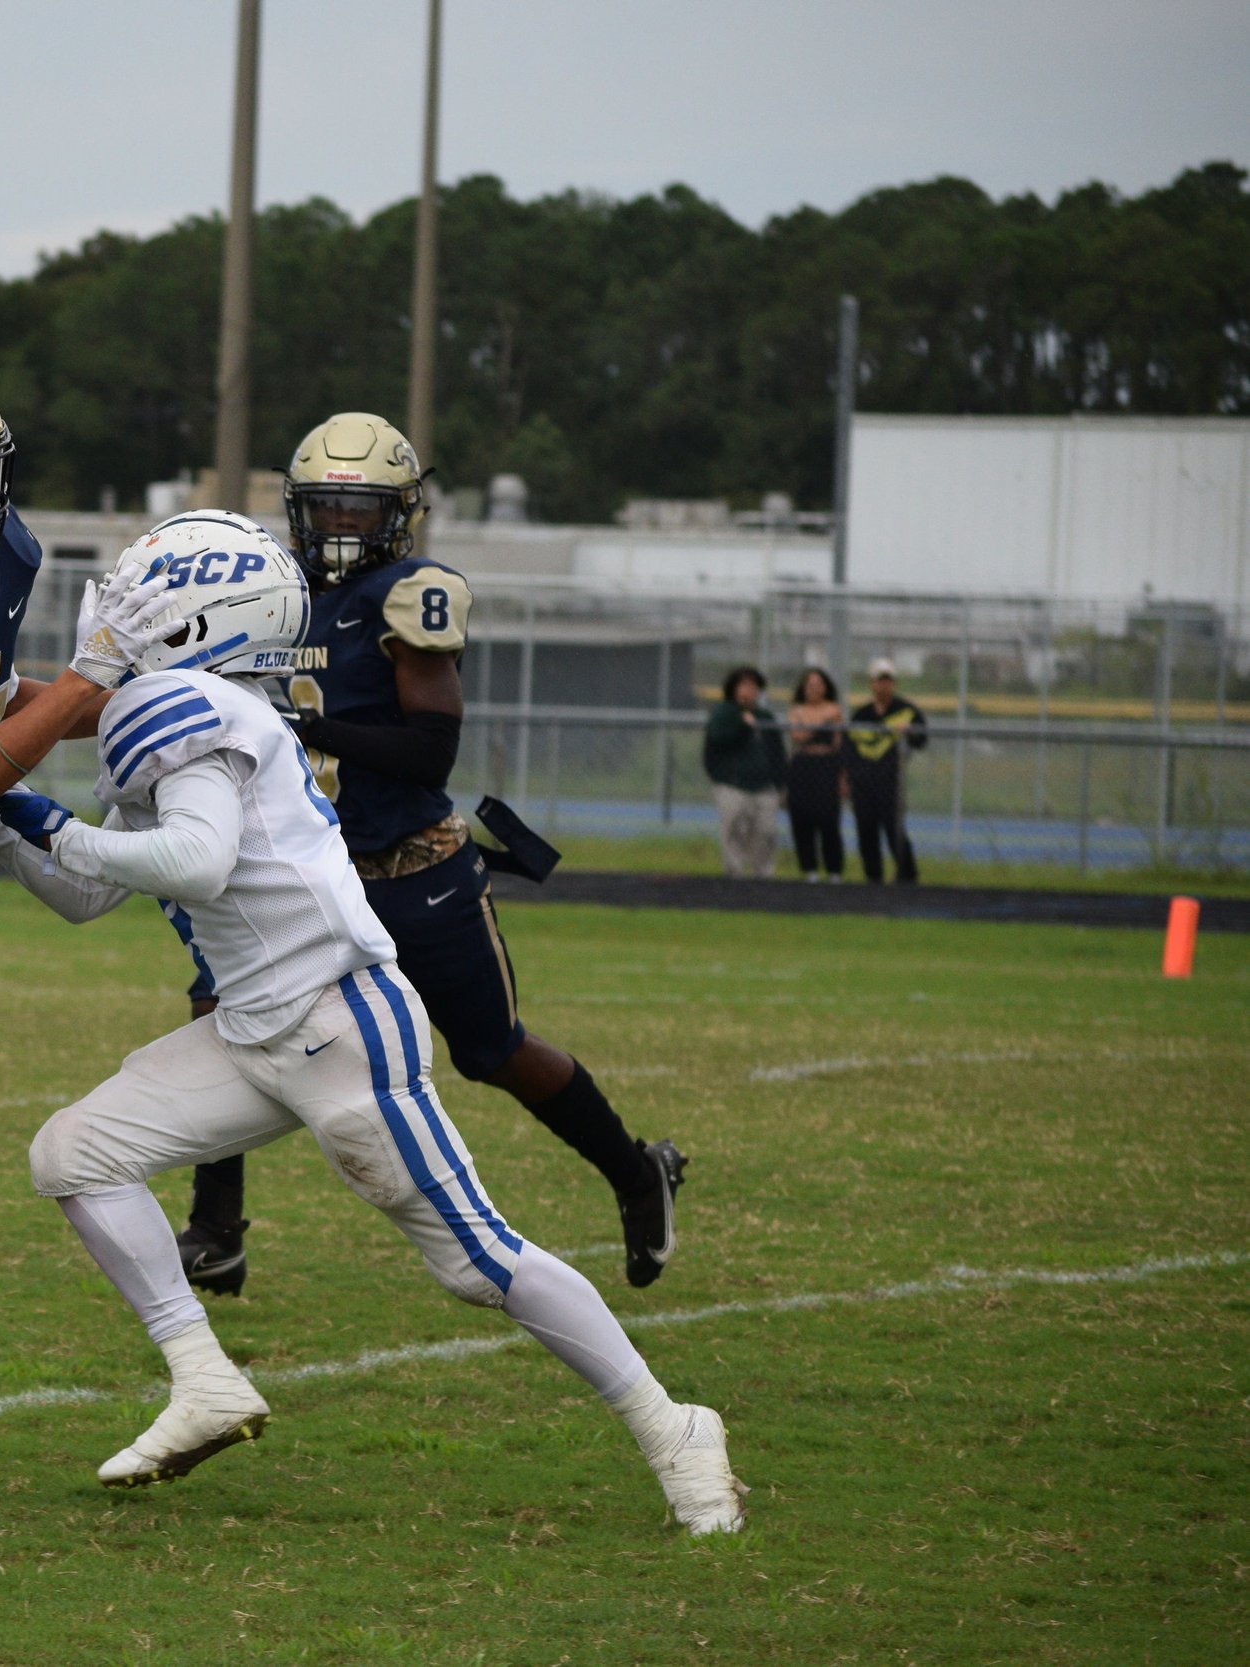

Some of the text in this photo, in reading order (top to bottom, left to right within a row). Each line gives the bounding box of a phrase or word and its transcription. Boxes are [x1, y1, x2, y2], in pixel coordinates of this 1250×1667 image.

[327, 472, 363, 481] Riddell
[165, 551, 267, 590] SCP
[421, 587, 449, 632] 8
[253, 652, 289, 668] BLUE
[296, 647, 328, 669] XON
